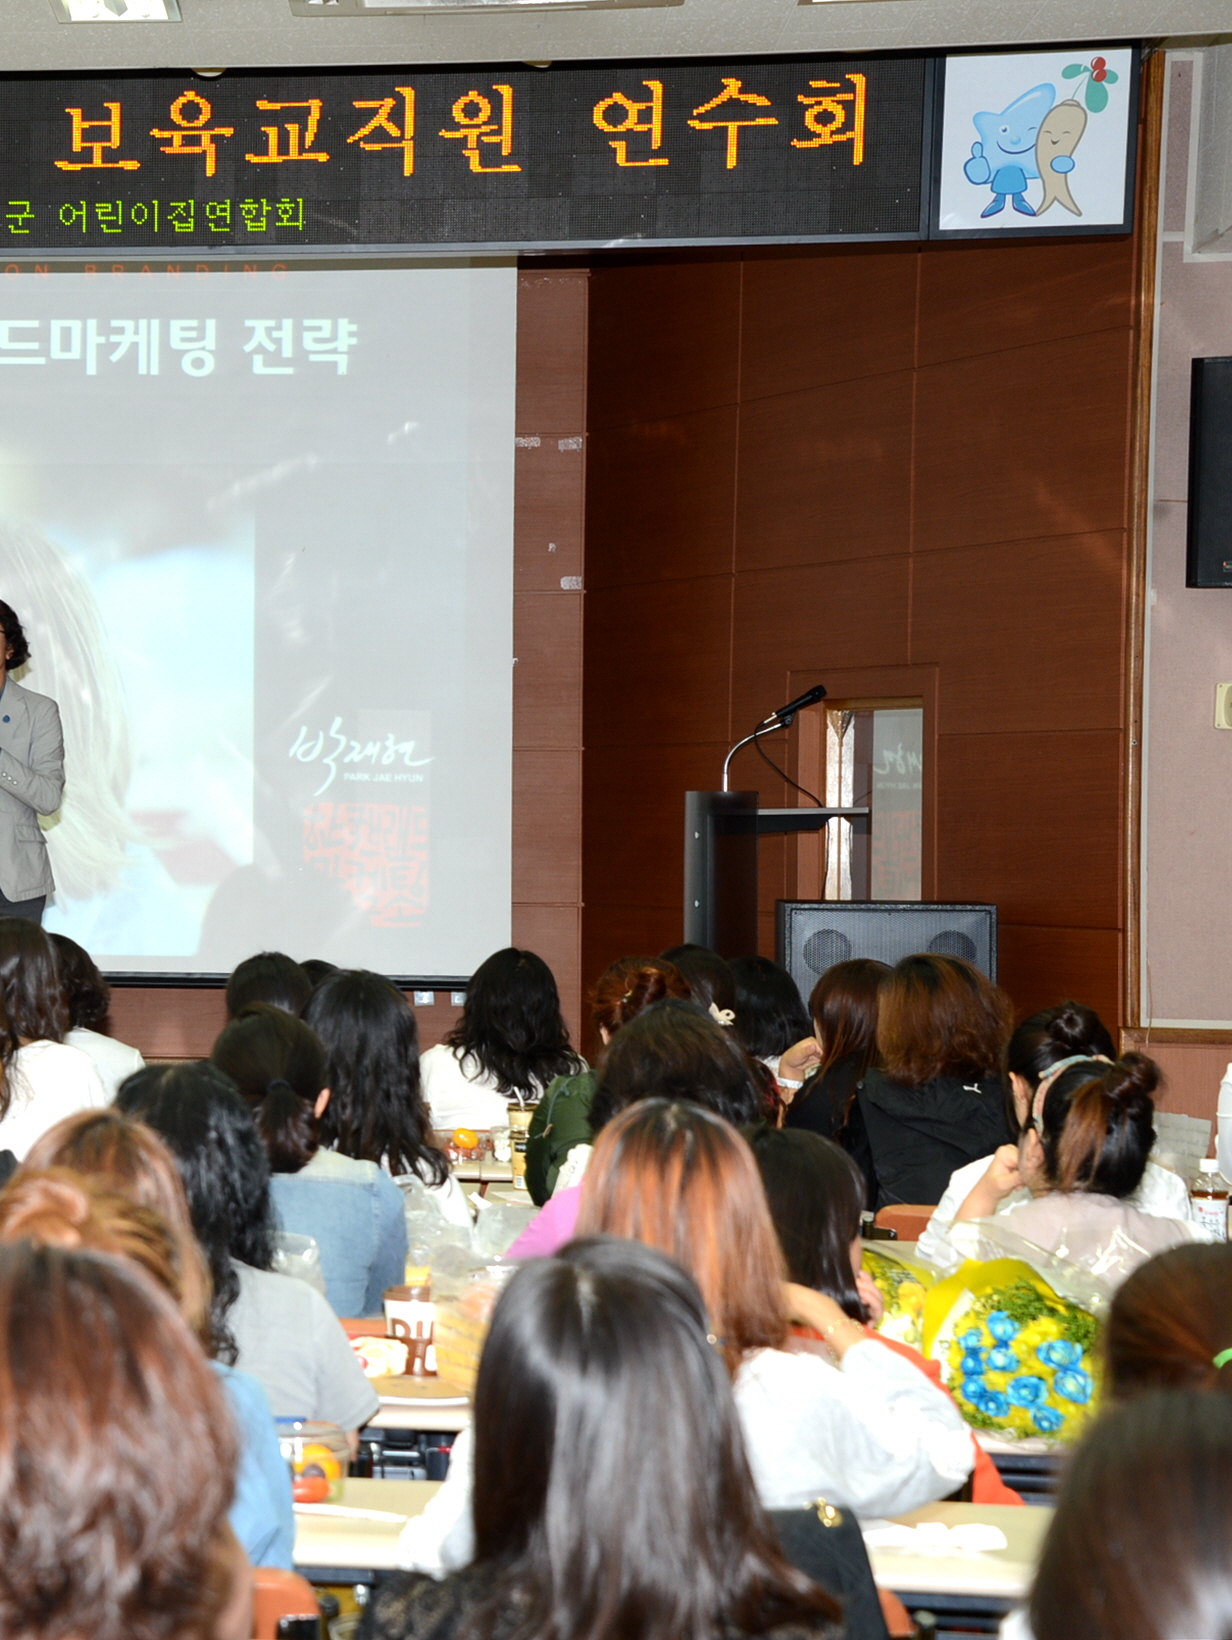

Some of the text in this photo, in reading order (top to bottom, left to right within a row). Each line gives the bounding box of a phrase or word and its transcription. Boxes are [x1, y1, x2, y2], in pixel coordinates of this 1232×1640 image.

[54, 86, 522, 176] 보육교직원
[593, 74, 866, 168] 연수회
[58, 197, 304, 233] 어린이집연합회
[83, 262, 288, 280] BRANDING
[242, 317, 359, 376] 전략
[343, 772, 424, 783] PARK JAE HYUN
